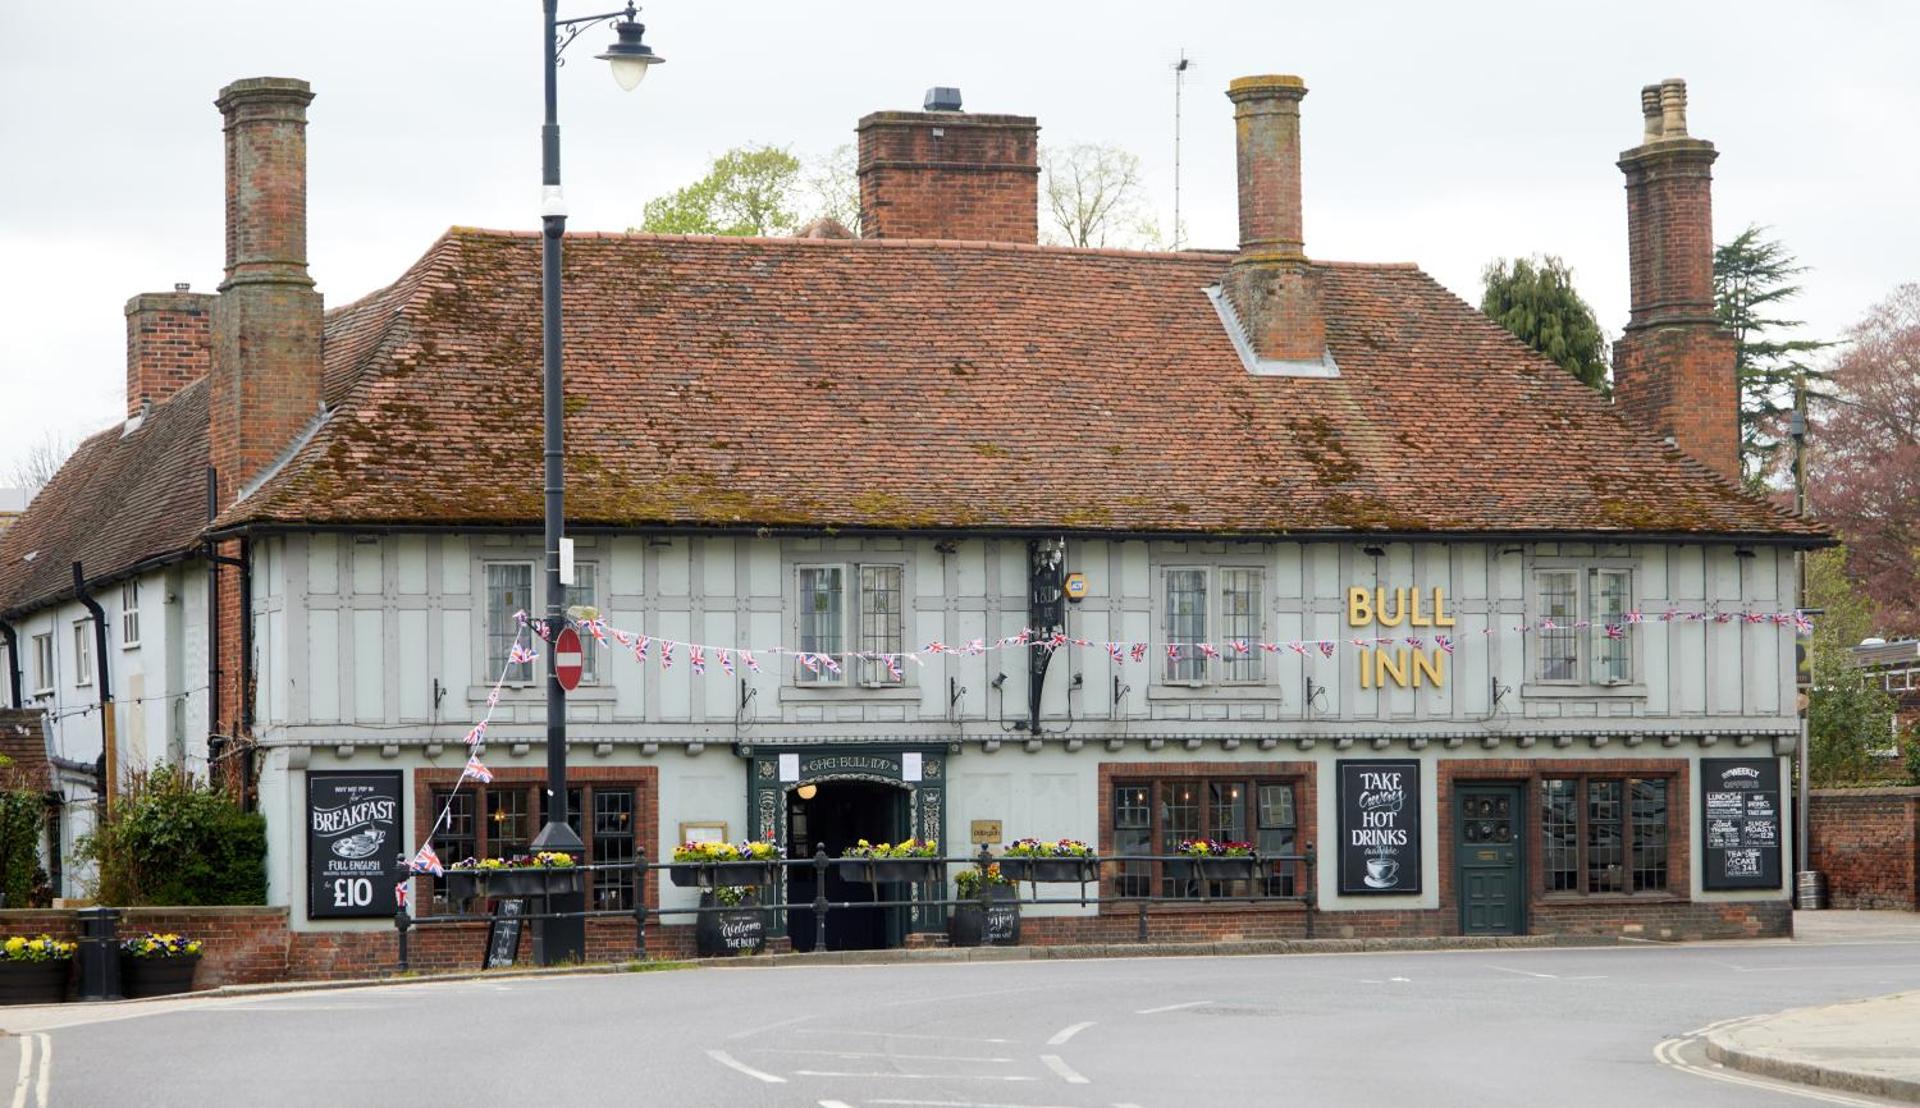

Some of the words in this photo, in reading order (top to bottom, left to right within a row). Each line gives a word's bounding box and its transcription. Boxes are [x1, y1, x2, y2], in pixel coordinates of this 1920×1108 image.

[1348, 586, 1456, 627] BULL
[1360, 648, 1443, 688] INN
[840, 756, 866, 768] BULL
[1730, 767, 1760, 778] WEEKLY
[1360, 772, 1403, 791] TAKE
[313, 801, 396, 832] BREAKFAST
[1362, 811, 1397, 827] HOT
[1352, 829, 1407, 845] DRINKS
[328, 860, 348, 870] FULL
[349, 860, 380, 870] ENGLISH
[334, 878, 373, 907] £10
[722, 920, 761, 937] Welcome
[725, 938, 740, 949] THE
[740, 937, 755, 948] BULL
